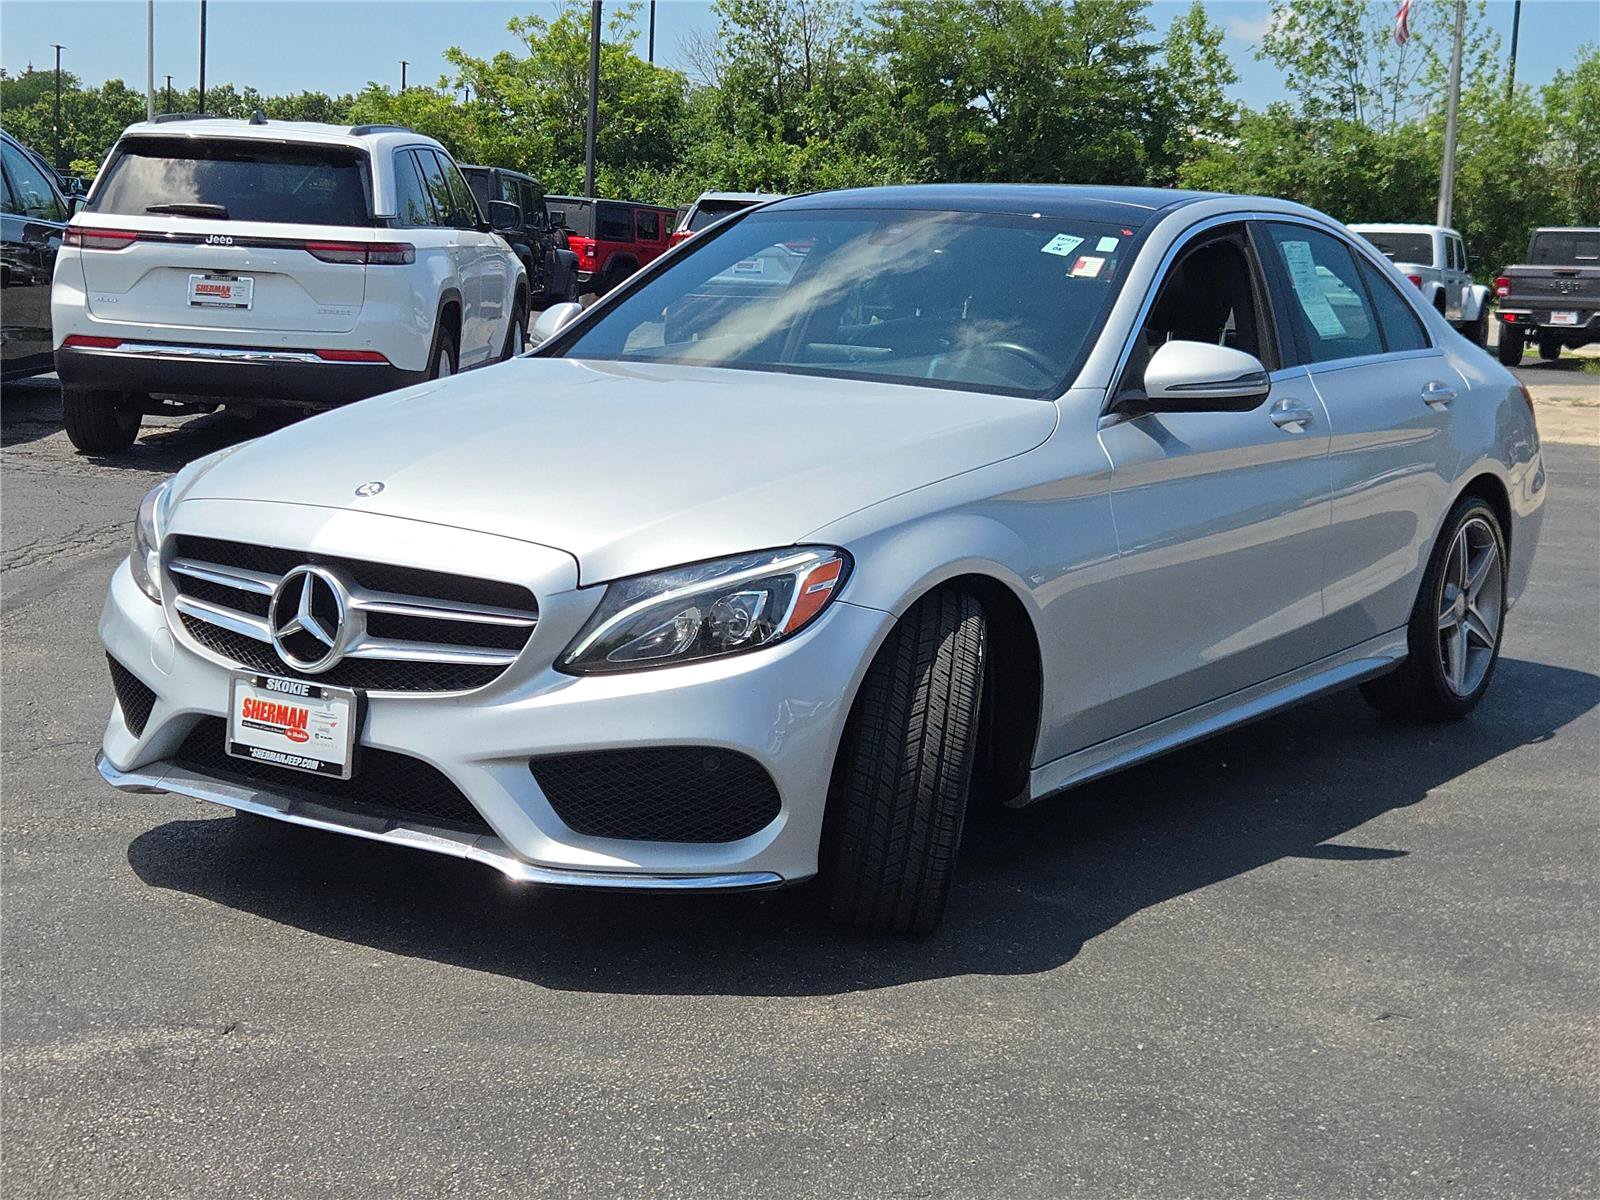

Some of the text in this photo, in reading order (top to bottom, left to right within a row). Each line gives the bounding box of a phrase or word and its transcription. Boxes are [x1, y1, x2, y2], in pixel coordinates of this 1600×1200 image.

[205, 235, 233, 244] Jeep
[196, 284, 231, 293] SHERMAN
[266, 678, 310, 696] SKOKIE
[242, 697, 309, 729] SHERMAN
